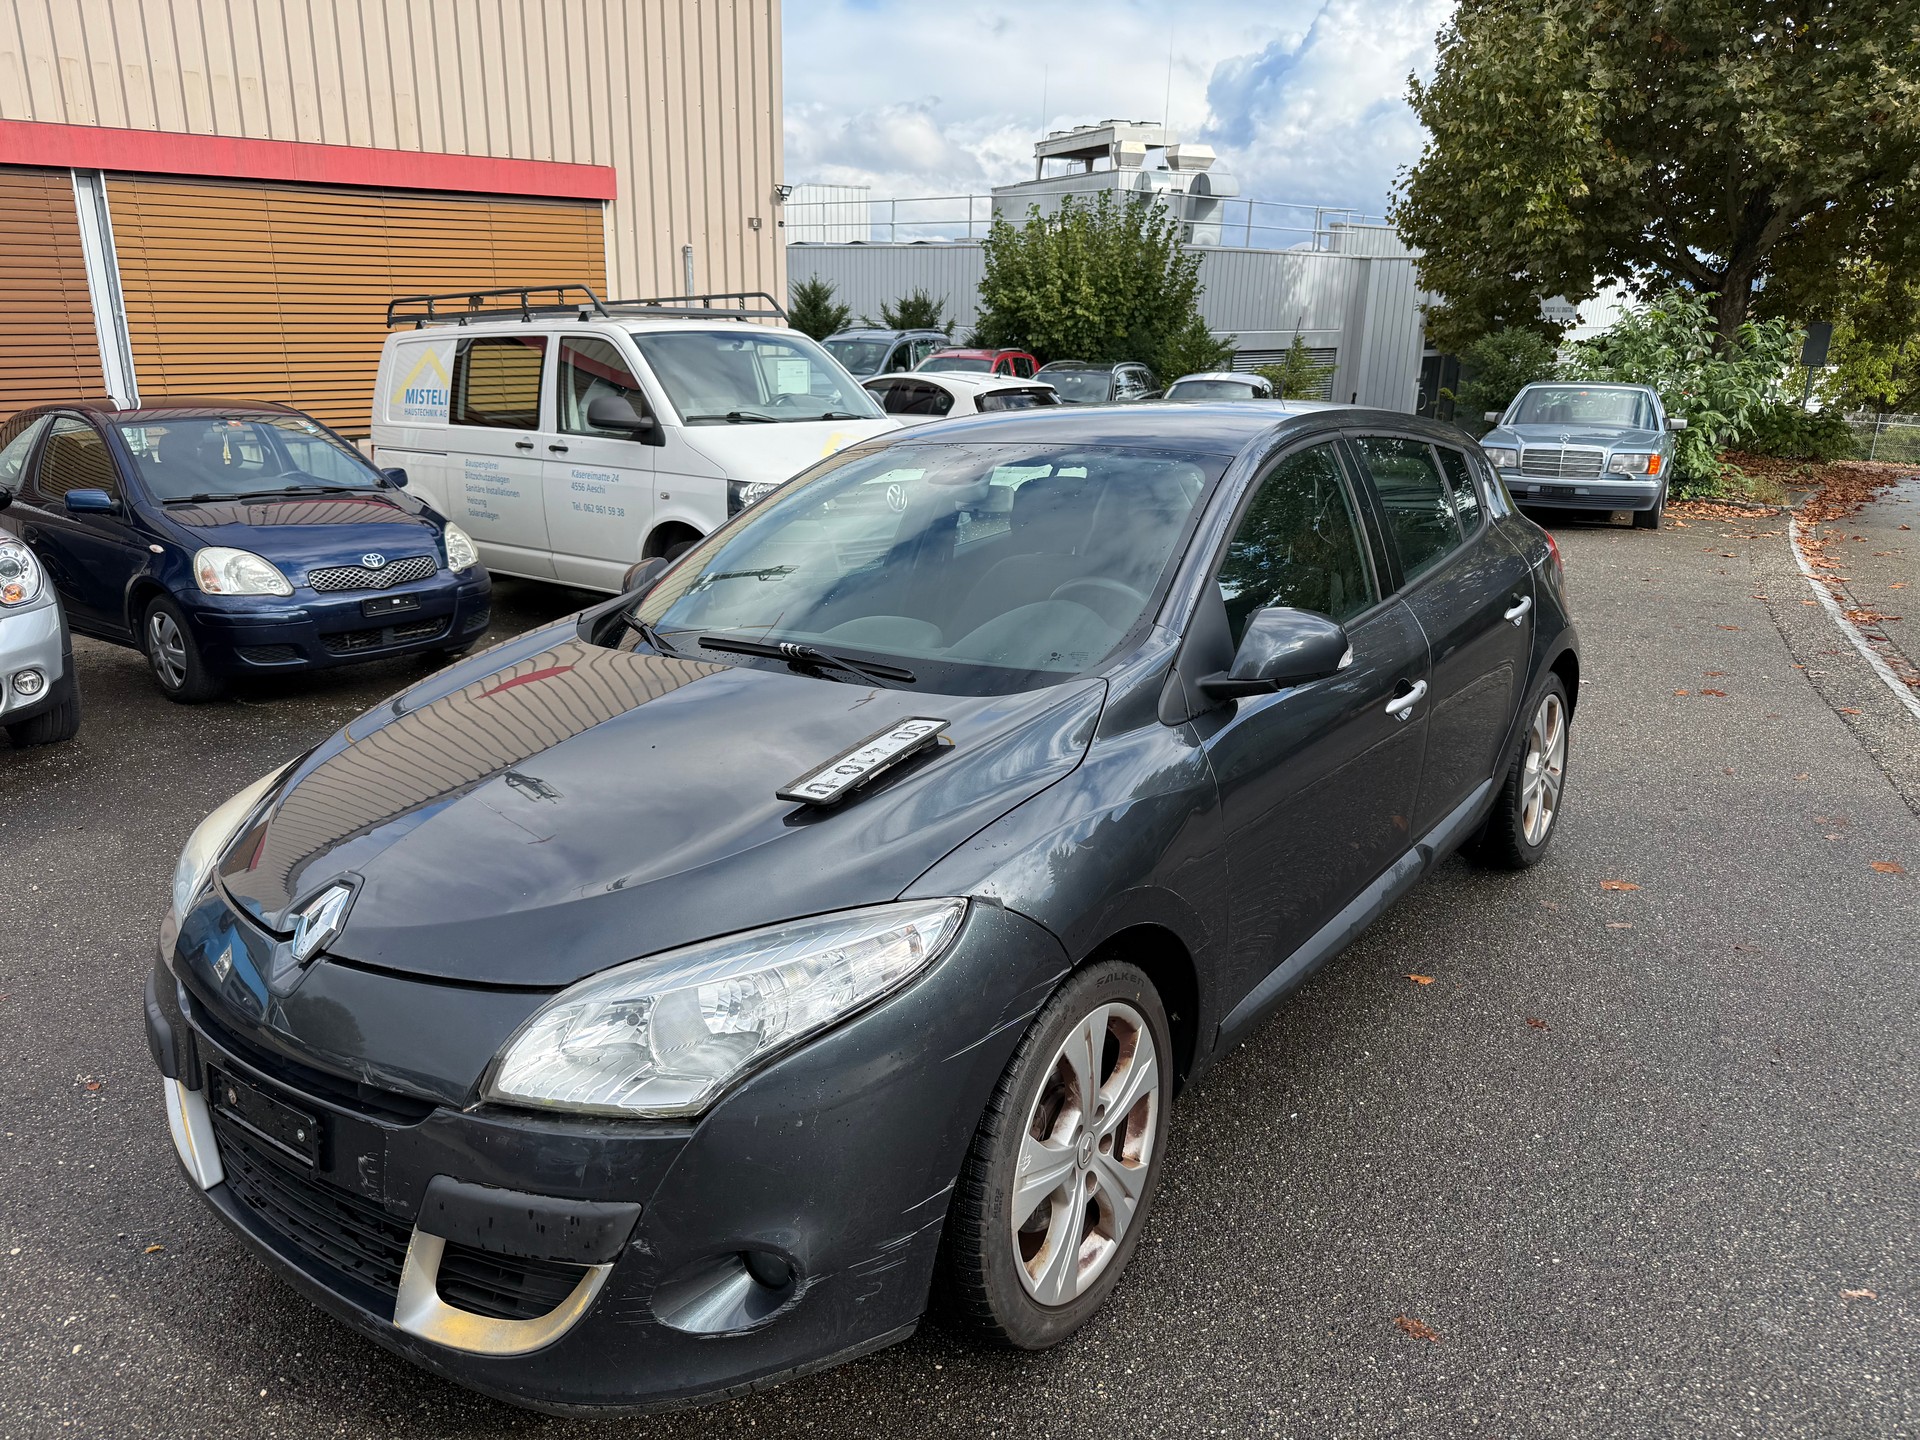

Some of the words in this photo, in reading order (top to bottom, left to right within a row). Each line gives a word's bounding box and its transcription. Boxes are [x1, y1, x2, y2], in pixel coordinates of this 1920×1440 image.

[405, 388, 448, 406] MISTELI
[404, 408, 438, 417] HAUSTECHNIK
[439, 409, 448, 418] AG
[465, 459, 499, 470] Bauspenglerei
[465, 471, 510, 485] Blitzschutzanlagen
[571, 469, 611, 482] Käsereimatte
[611, 473, 620, 483] 24
[465, 483, 485, 494] Sanitäre
[486, 486, 520, 498] Installationen
[570, 482, 586, 492] 4556
[586, 484, 606, 494] Aeschi
[466, 496, 487, 508] Heizung
[571, 501, 583, 512] Tel.
[583, 503, 595, 513] 062
[595, 505, 607, 515] 961
[607, 506, 616, 516] 59
[616, 507, 625, 517] 38
[468, 507, 500, 521] Solaranlagen
[1095, 972, 1145, 988] FALKEN
